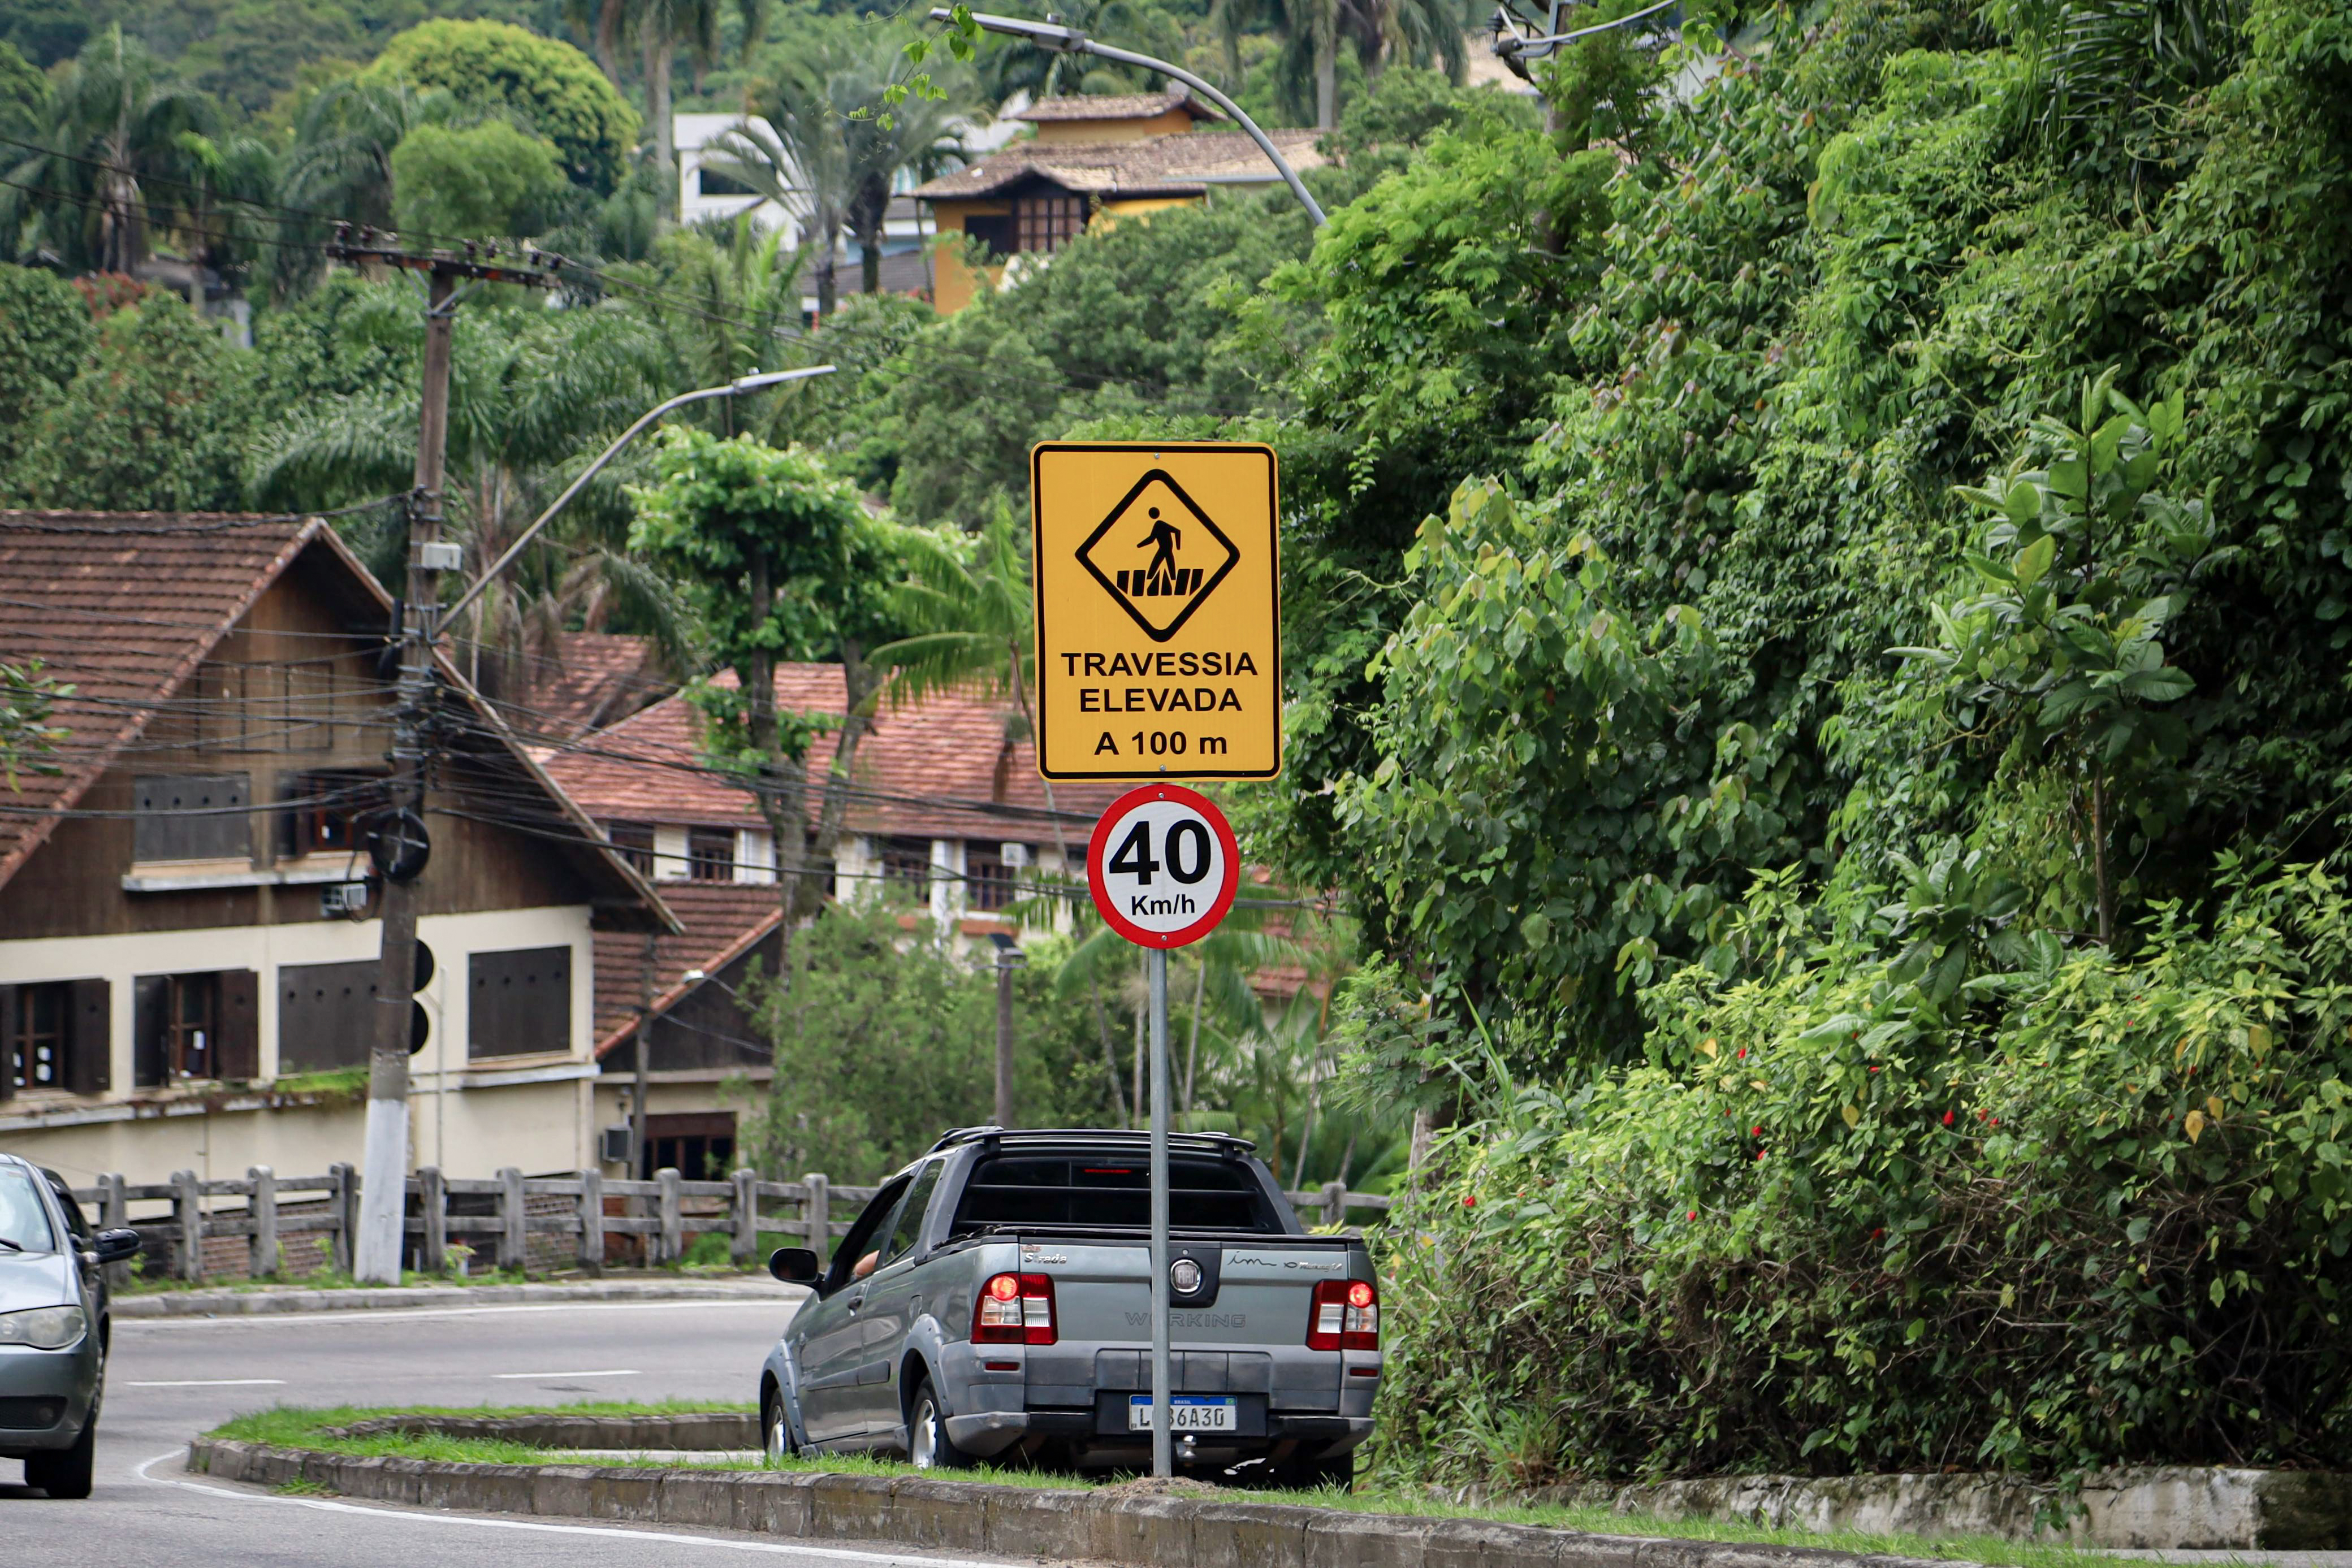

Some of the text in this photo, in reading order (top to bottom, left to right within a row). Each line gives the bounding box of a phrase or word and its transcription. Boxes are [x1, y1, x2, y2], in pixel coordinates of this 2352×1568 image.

[1061, 652, 1259, 677] TRAVESSIA
[1080, 688, 1243, 712] ELEVADA
[1093, 731, 1227, 756] A 100 m
[1109, 819, 1212, 886] 40
[1130, 894, 1196, 916] Km/h
[1024, 1252, 1067, 1264] Srada
[1125, 1312, 1246, 1328] WRKING
[1139, 1407, 1225, 1427] L6A30
